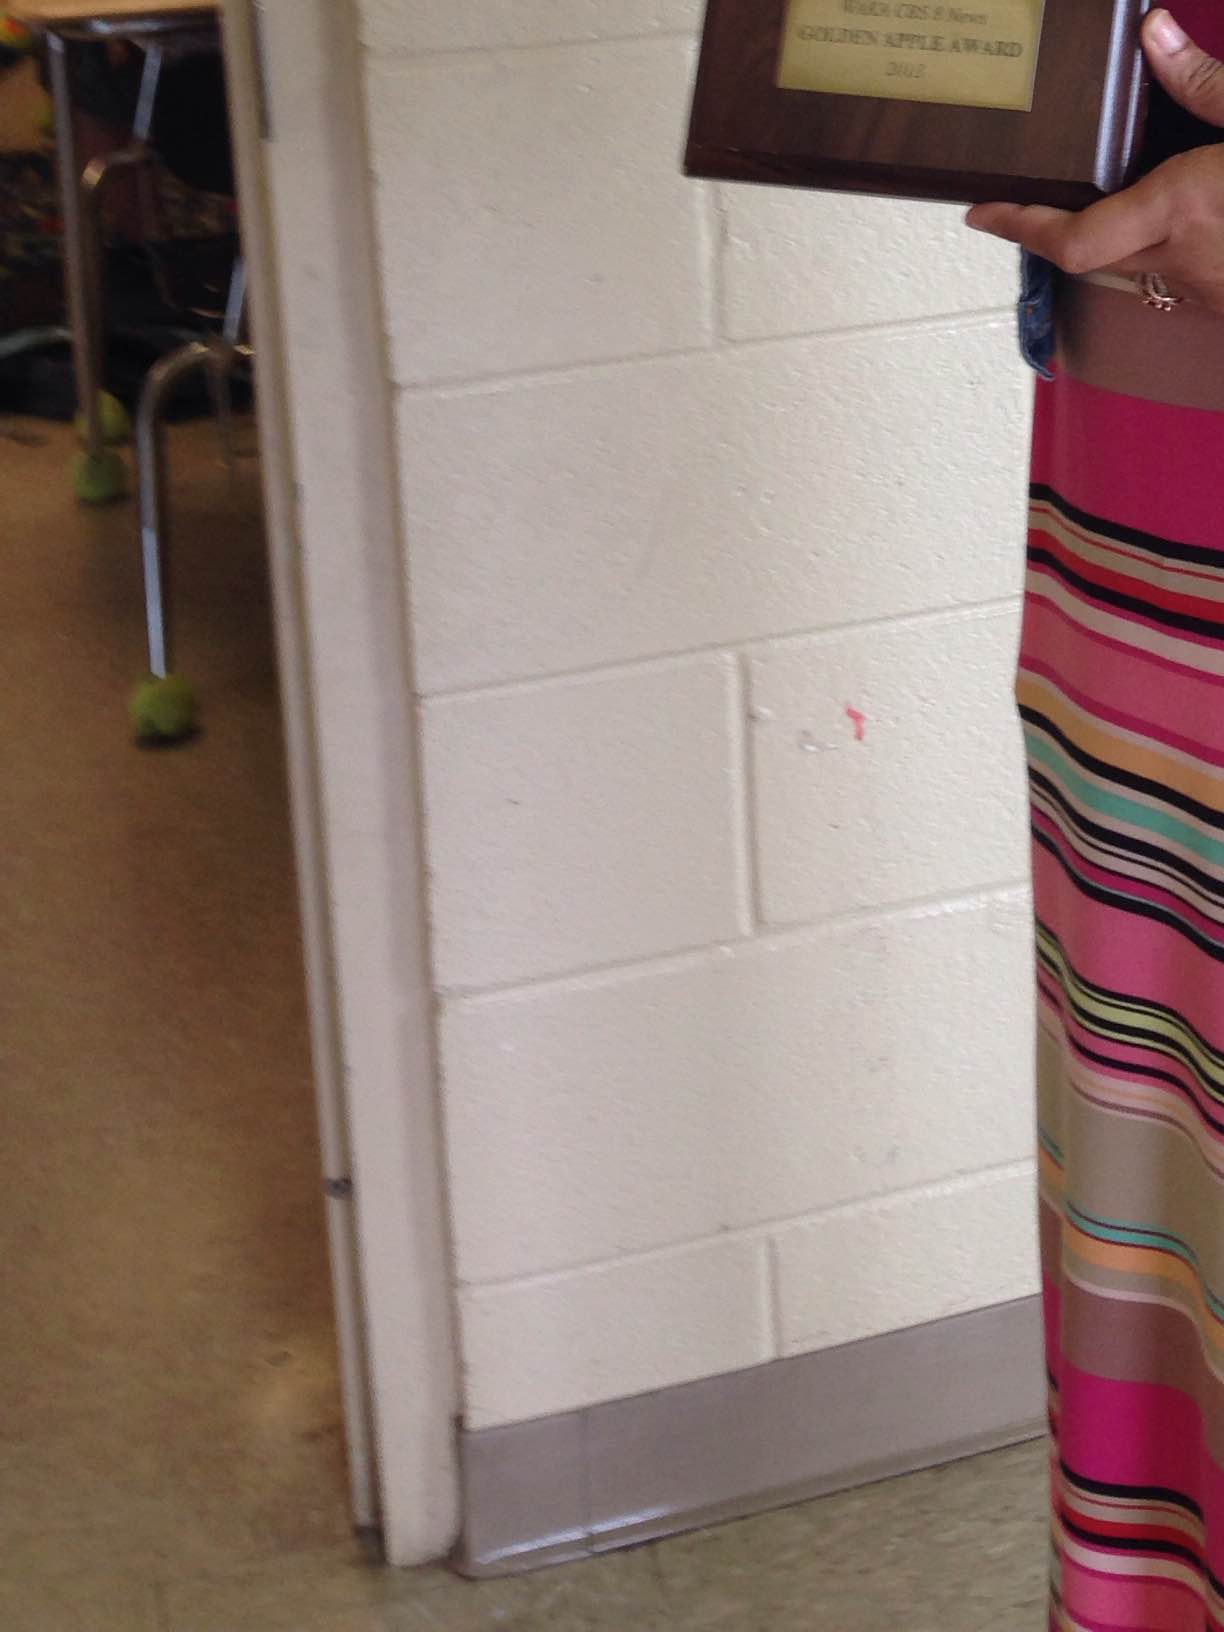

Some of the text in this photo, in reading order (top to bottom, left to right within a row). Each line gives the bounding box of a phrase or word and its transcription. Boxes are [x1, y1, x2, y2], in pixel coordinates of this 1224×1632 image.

[798, 25, 1023, 58] GOLDEN APPLE AWARD
